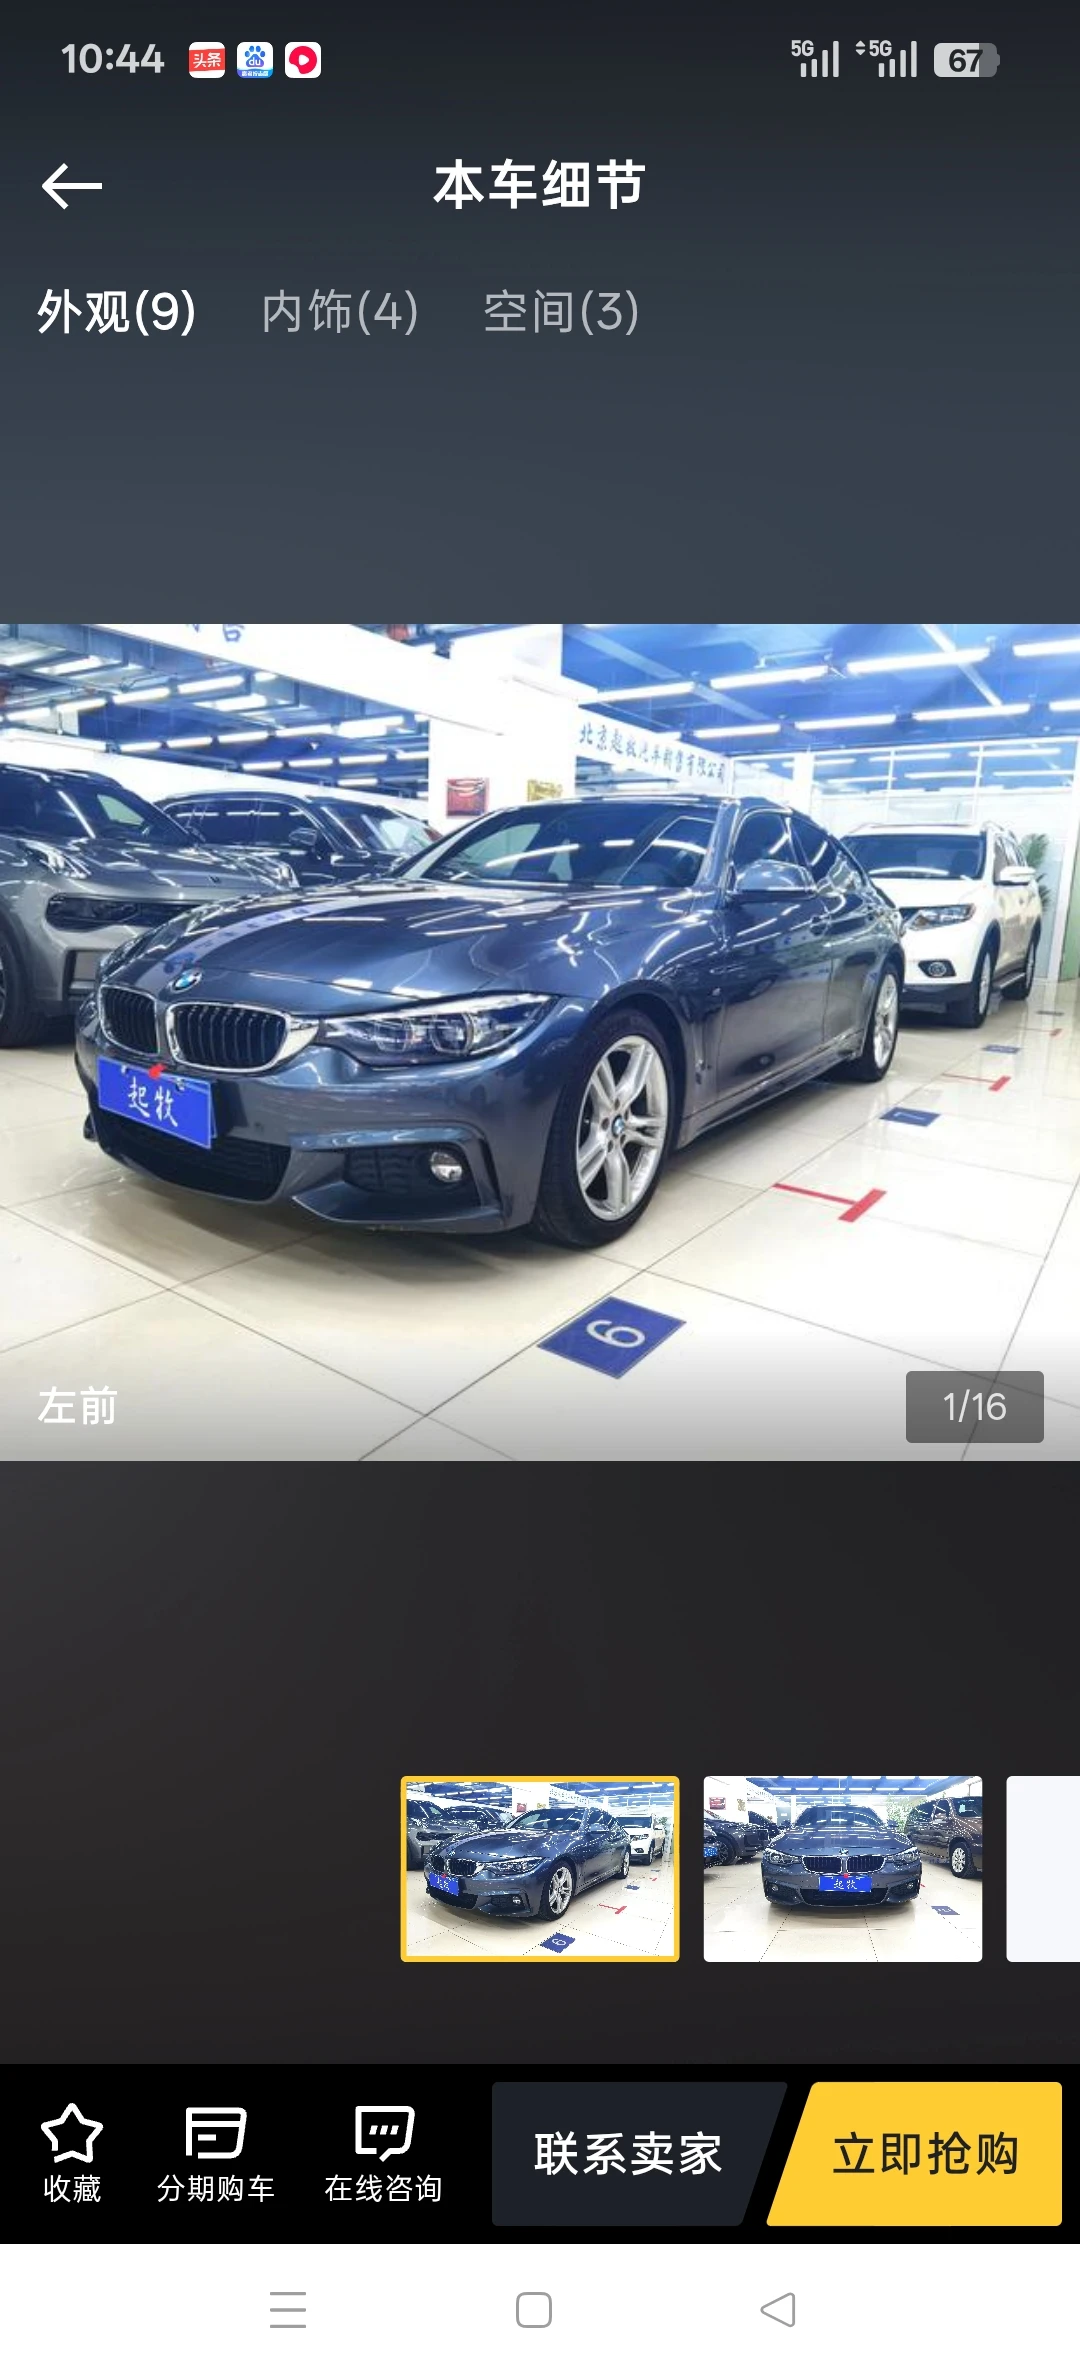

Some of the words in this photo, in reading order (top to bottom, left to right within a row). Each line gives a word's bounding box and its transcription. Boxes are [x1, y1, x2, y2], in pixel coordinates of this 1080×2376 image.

[62, 43, 165, 73] 10:44
[193, 52, 221, 68] 头条
[791, 40, 814, 56] 5G
[869, 40, 892, 56] 5G
[949, 49, 983, 72] 67
[433, 158, 645, 209] 本车细节
[37, 289, 194, 336] 外观(9)
[264, 289, 417, 335] 内饰(4)
[485, 289, 637, 335] 空间(3)
[128, 1076, 178, 1127] 起牧
[534, 2131, 722, 2175] 联系卖家
[833, 2131, 1017, 2175] 立即抢购
[44, 2174, 101, 2203] 收藏
[158, 2174, 274, 2202] 分期购车
[325, 2174, 441, 2202] 在线咨询
